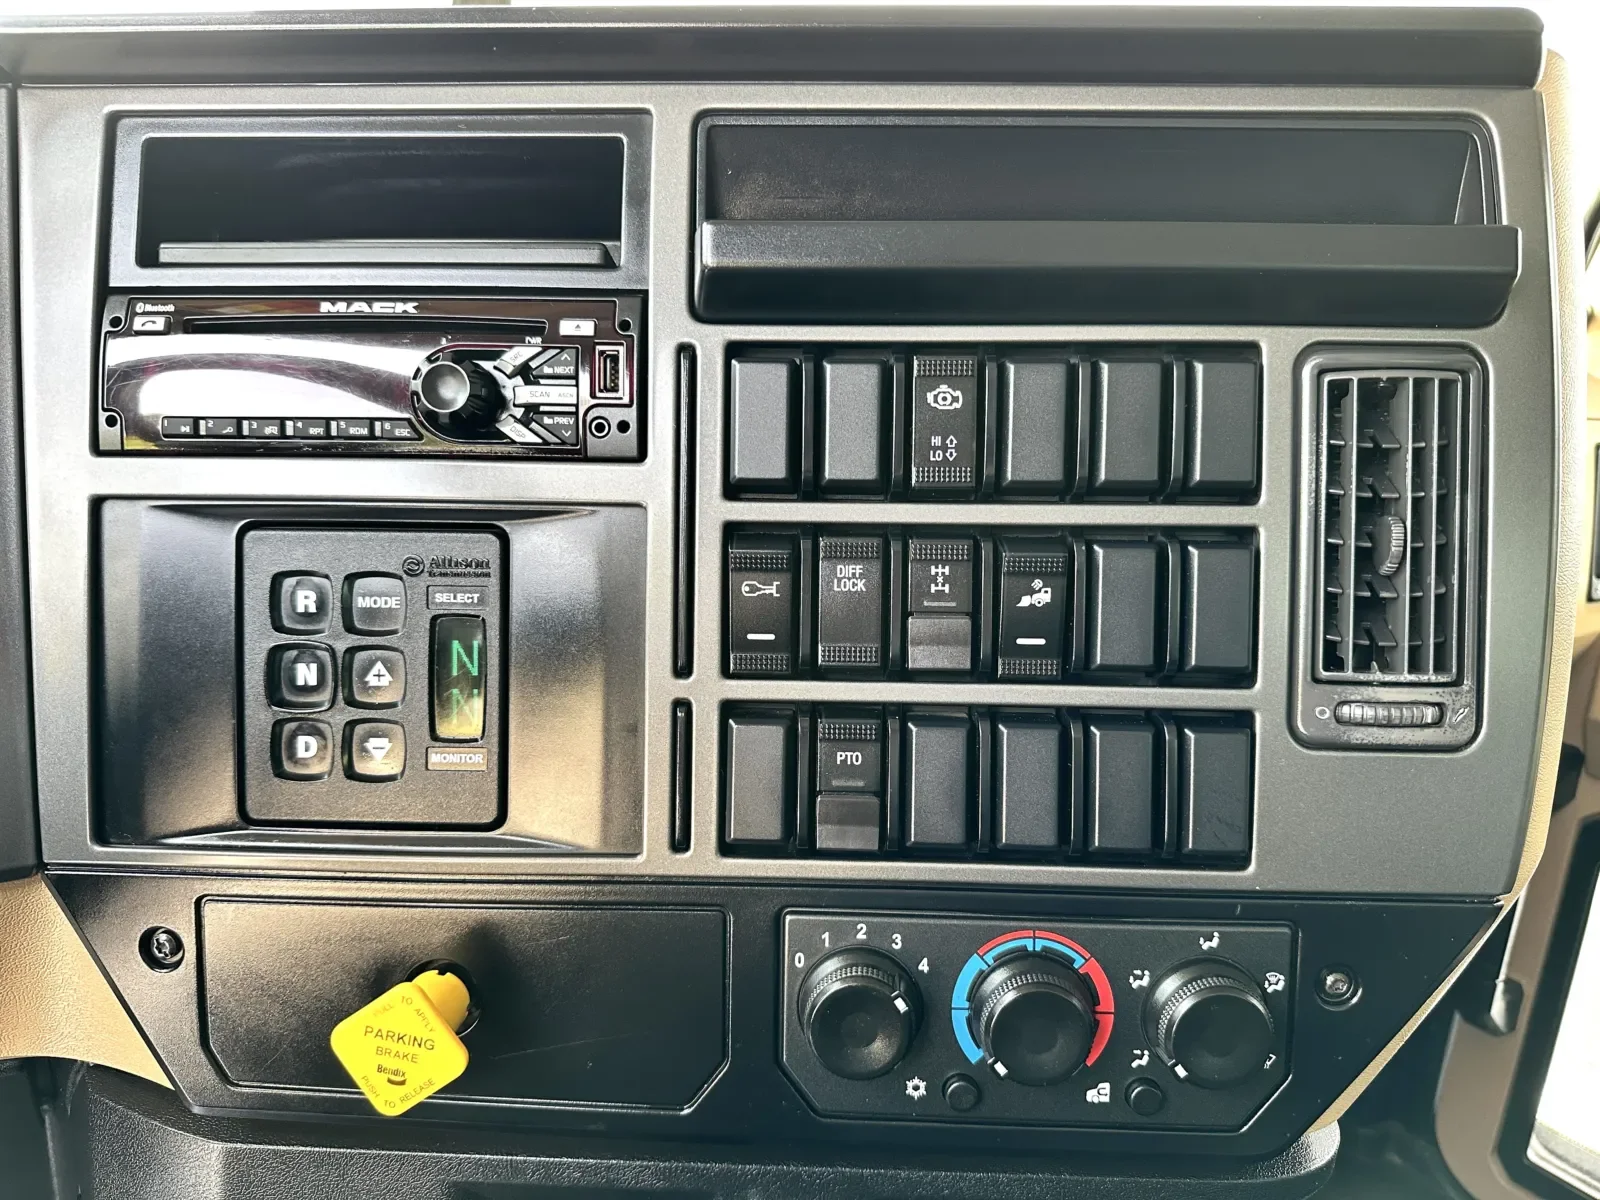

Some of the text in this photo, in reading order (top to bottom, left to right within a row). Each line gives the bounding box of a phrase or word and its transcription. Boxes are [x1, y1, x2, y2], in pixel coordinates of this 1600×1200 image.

[144, 304, 175, 312] Bluetooth
[320, 301, 419, 313] MACK
[554, 366, 574, 374] NEXT
[251, 421, 258, 429] 3
[296, 421, 303, 429] 4
[340, 421, 346, 429] 5
[384, 422, 391, 430] 6
[554, 417, 574, 425] PREV
[309, 427, 324, 435] RPT
[349, 427, 368, 435] RDM
[395, 428, 411, 436] ESC
[931, 435, 942, 447] HI
[930, 450, 943, 461] LO
[429, 555, 491, 569] Allison
[836, 564, 863, 578] DIFF
[833, 578, 867, 592] LOCK
[296, 590, 317, 613] R
[357, 596, 401, 608] MODE
[435, 593, 480, 603] SELECT
[452, 639, 479, 676] N
[297, 663, 318, 686] N
[297, 735, 318, 758] D
[431, 753, 483, 763] MONITOR
[836, 751, 862, 765] PTO
[856, 923, 867, 939] 2
[821, 932, 830, 948] 1
[892, 934, 902, 949] 3
[794, 953, 805, 968] 0
[918, 957, 930, 974] 4
[401, 995, 413, 1006] TO
[414, 1007, 436, 1034] APPLY
[364, 1025, 436, 1051] PARKING
[375, 1045, 420, 1064] BRAKE
[376, 1063, 406, 1079] Bendix
[361, 1075, 436, 1109] PUSH TO RELEASE
